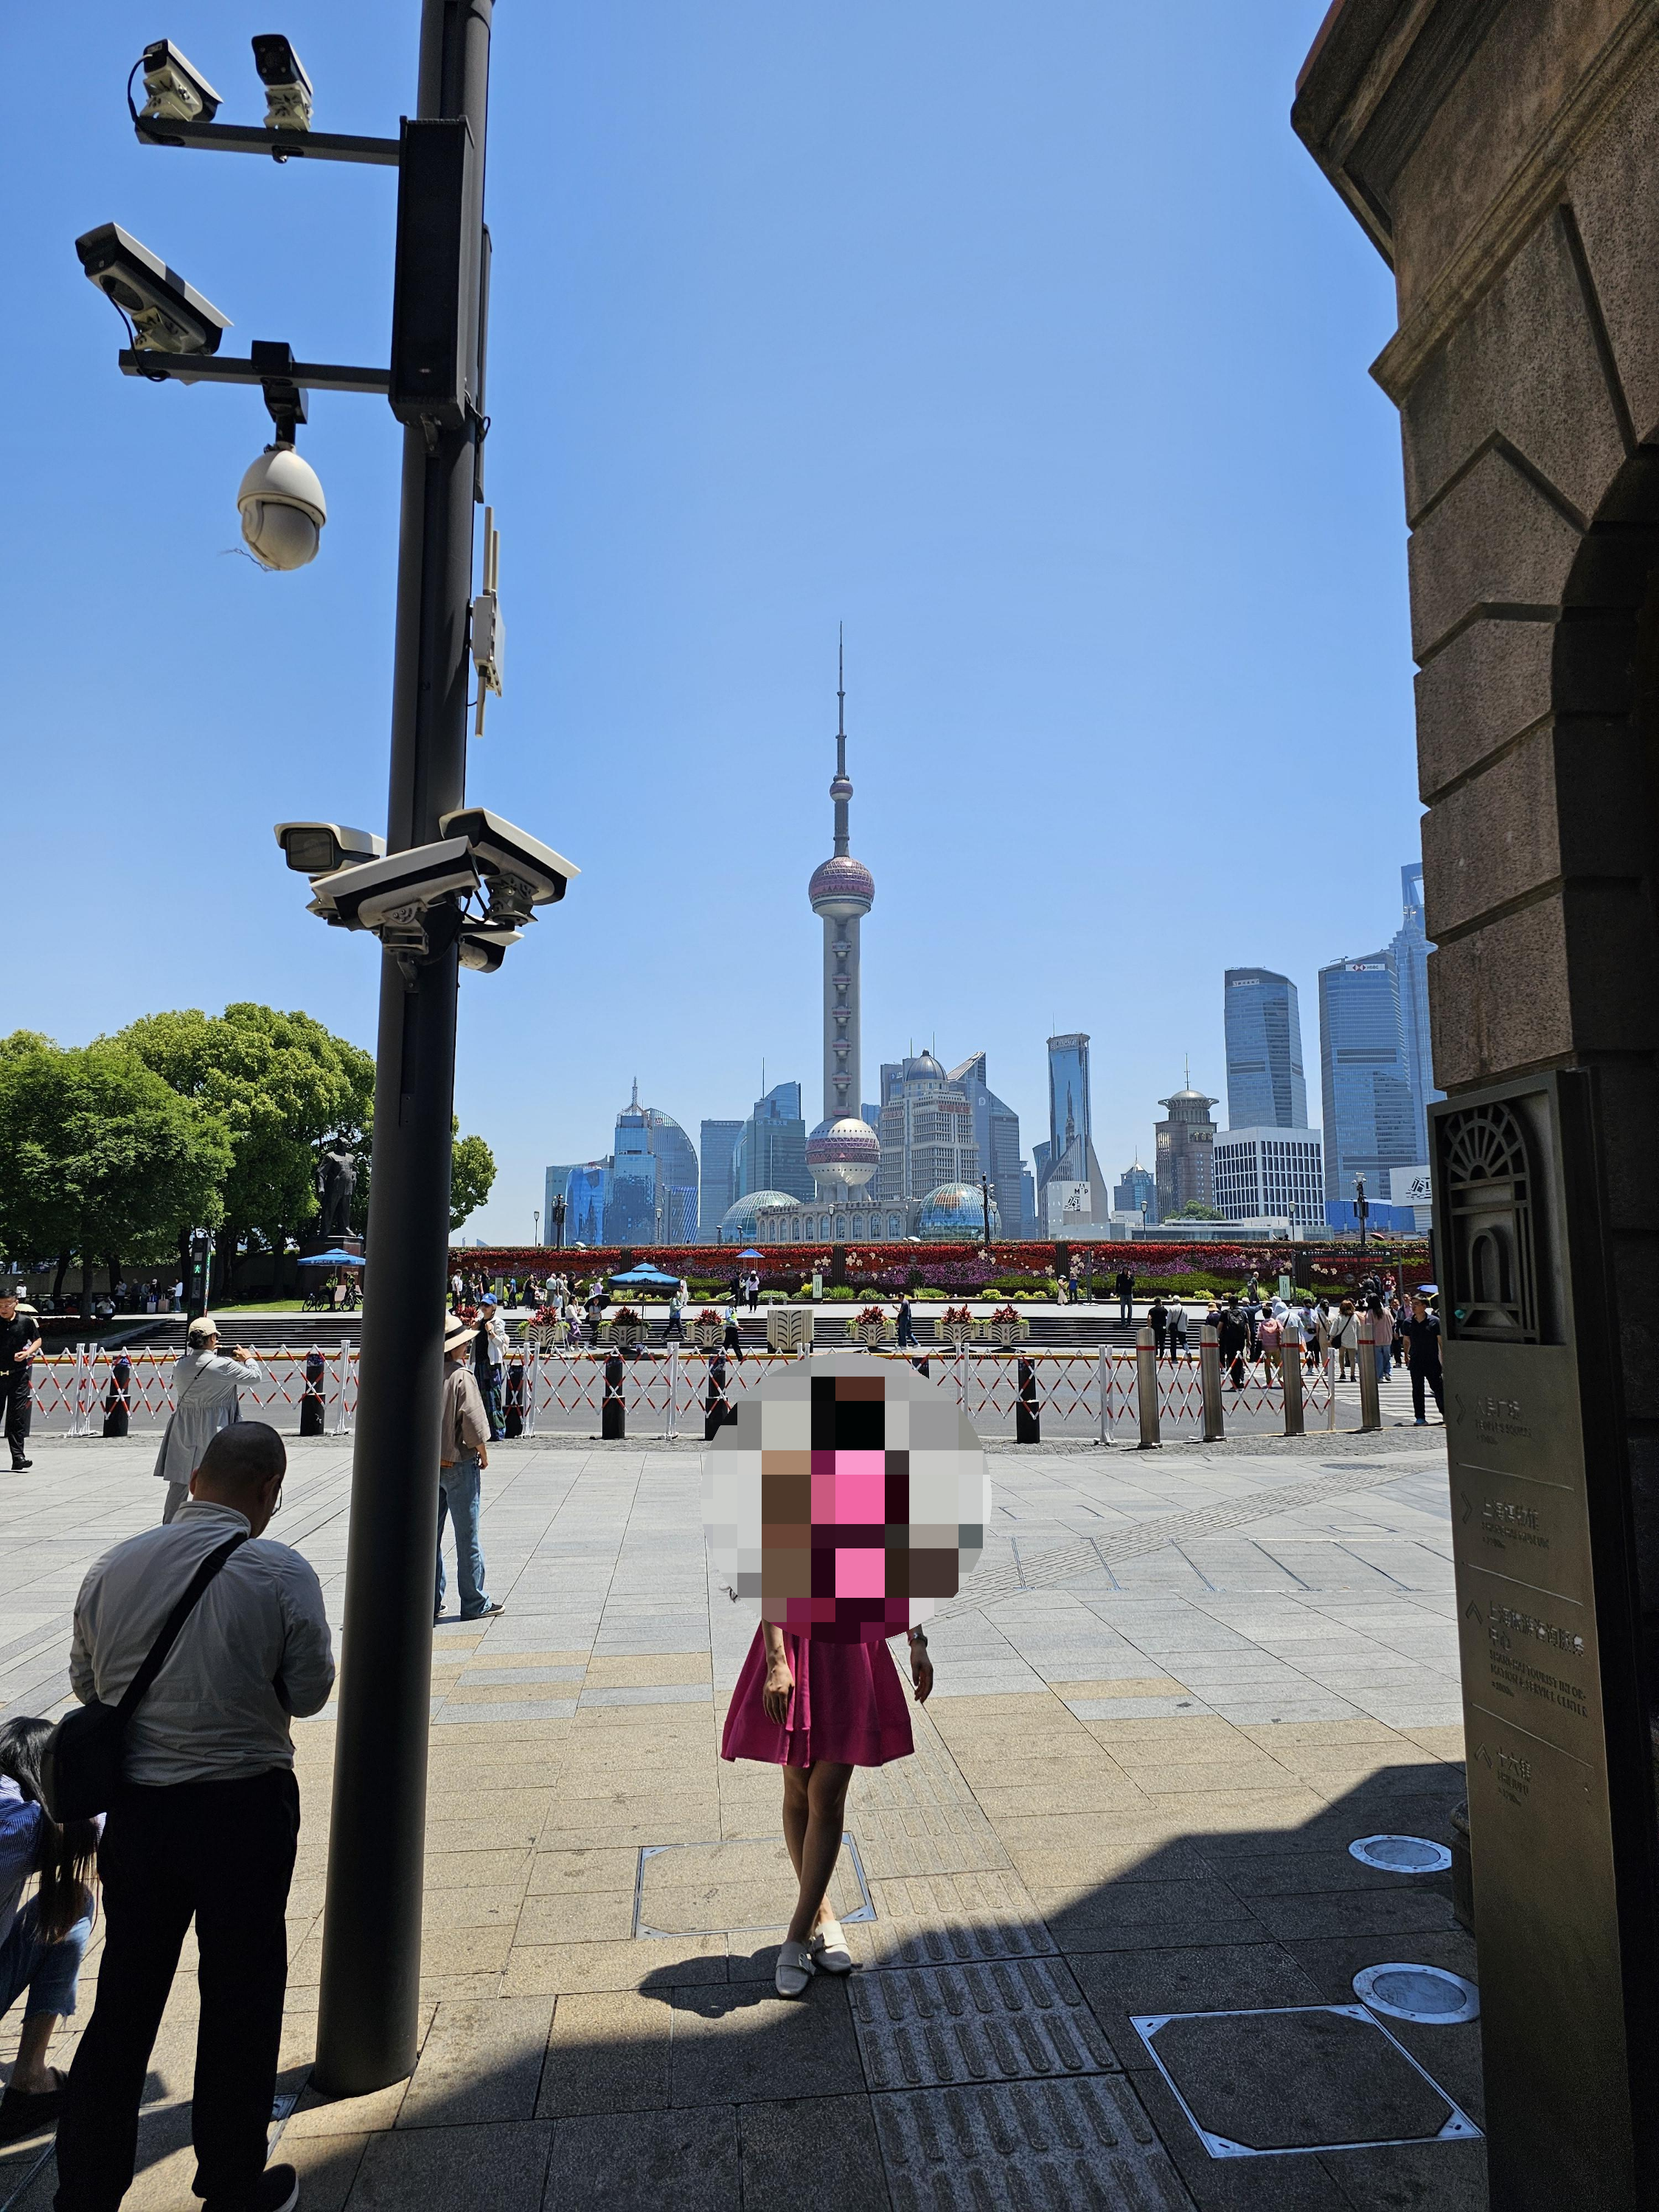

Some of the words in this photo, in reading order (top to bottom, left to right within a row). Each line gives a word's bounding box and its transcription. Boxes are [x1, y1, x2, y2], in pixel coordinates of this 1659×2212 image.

[1487, 1601, 1585, 1658] 上海旅游咨询服务
[1489, 1626, 1512, 1651] 中心
[1489, 1649, 1526, 1674] SHANGHAI
[1526, 1664, 1557, 1688] TOURIST
[1526, 1680, 1555, 1703] SERVICE
